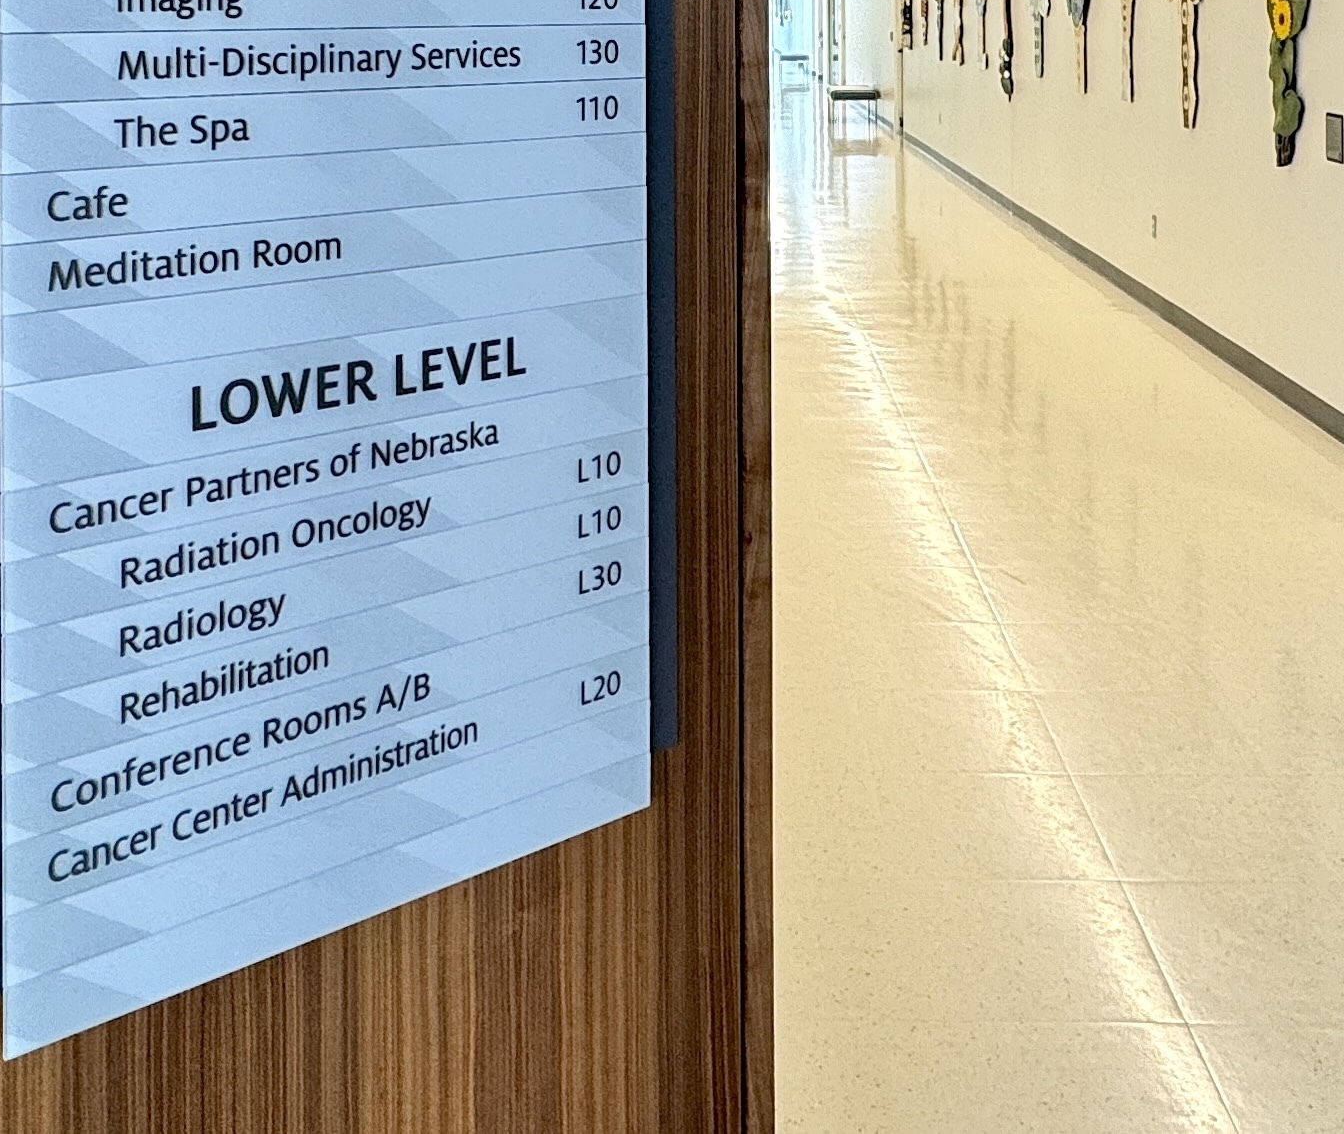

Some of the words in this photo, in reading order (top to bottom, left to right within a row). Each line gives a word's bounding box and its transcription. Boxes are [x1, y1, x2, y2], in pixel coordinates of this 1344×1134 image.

[117, 42, 402, 82] Multi-Disciplinary
[411, 43, 521, 71] Services
[576, 39, 619, 65] 130
[113, 115, 178, 149] The
[190, 114, 250, 151] Spa
[576, 95, 619, 122] 110
[47, 185, 128, 222] Cafe
[47, 244, 240, 292] Meditation
[253, 237, 342, 269] Room
[191, 359, 378, 432] LOWER
[395, 336, 527, 397] LEVEL
[49, 487, 174, 534] Cancer
[186, 458, 320, 507] Partners
[329, 442, 362, 477] of
[371, 420, 499, 470] Nebraska
[120, 531, 280, 589] Radiation
[291, 496, 432, 548] Oncology
[578, 450, 622, 484] L10
[119, 593, 287, 657] Radiology
[578, 505, 622, 539] L10
[119, 642, 330, 725] Rehabilitation
[578, 560, 622, 595] L30
[48, 823, 163, 882] Cancer
[172, 788, 273, 841] Center
[280, 719, 479, 808] Administration
[580, 670, 621, 706] L20
[51, 731, 253, 813] Conference
[263, 696, 367, 749] Rooms
[375, 673, 431, 715] A/B
